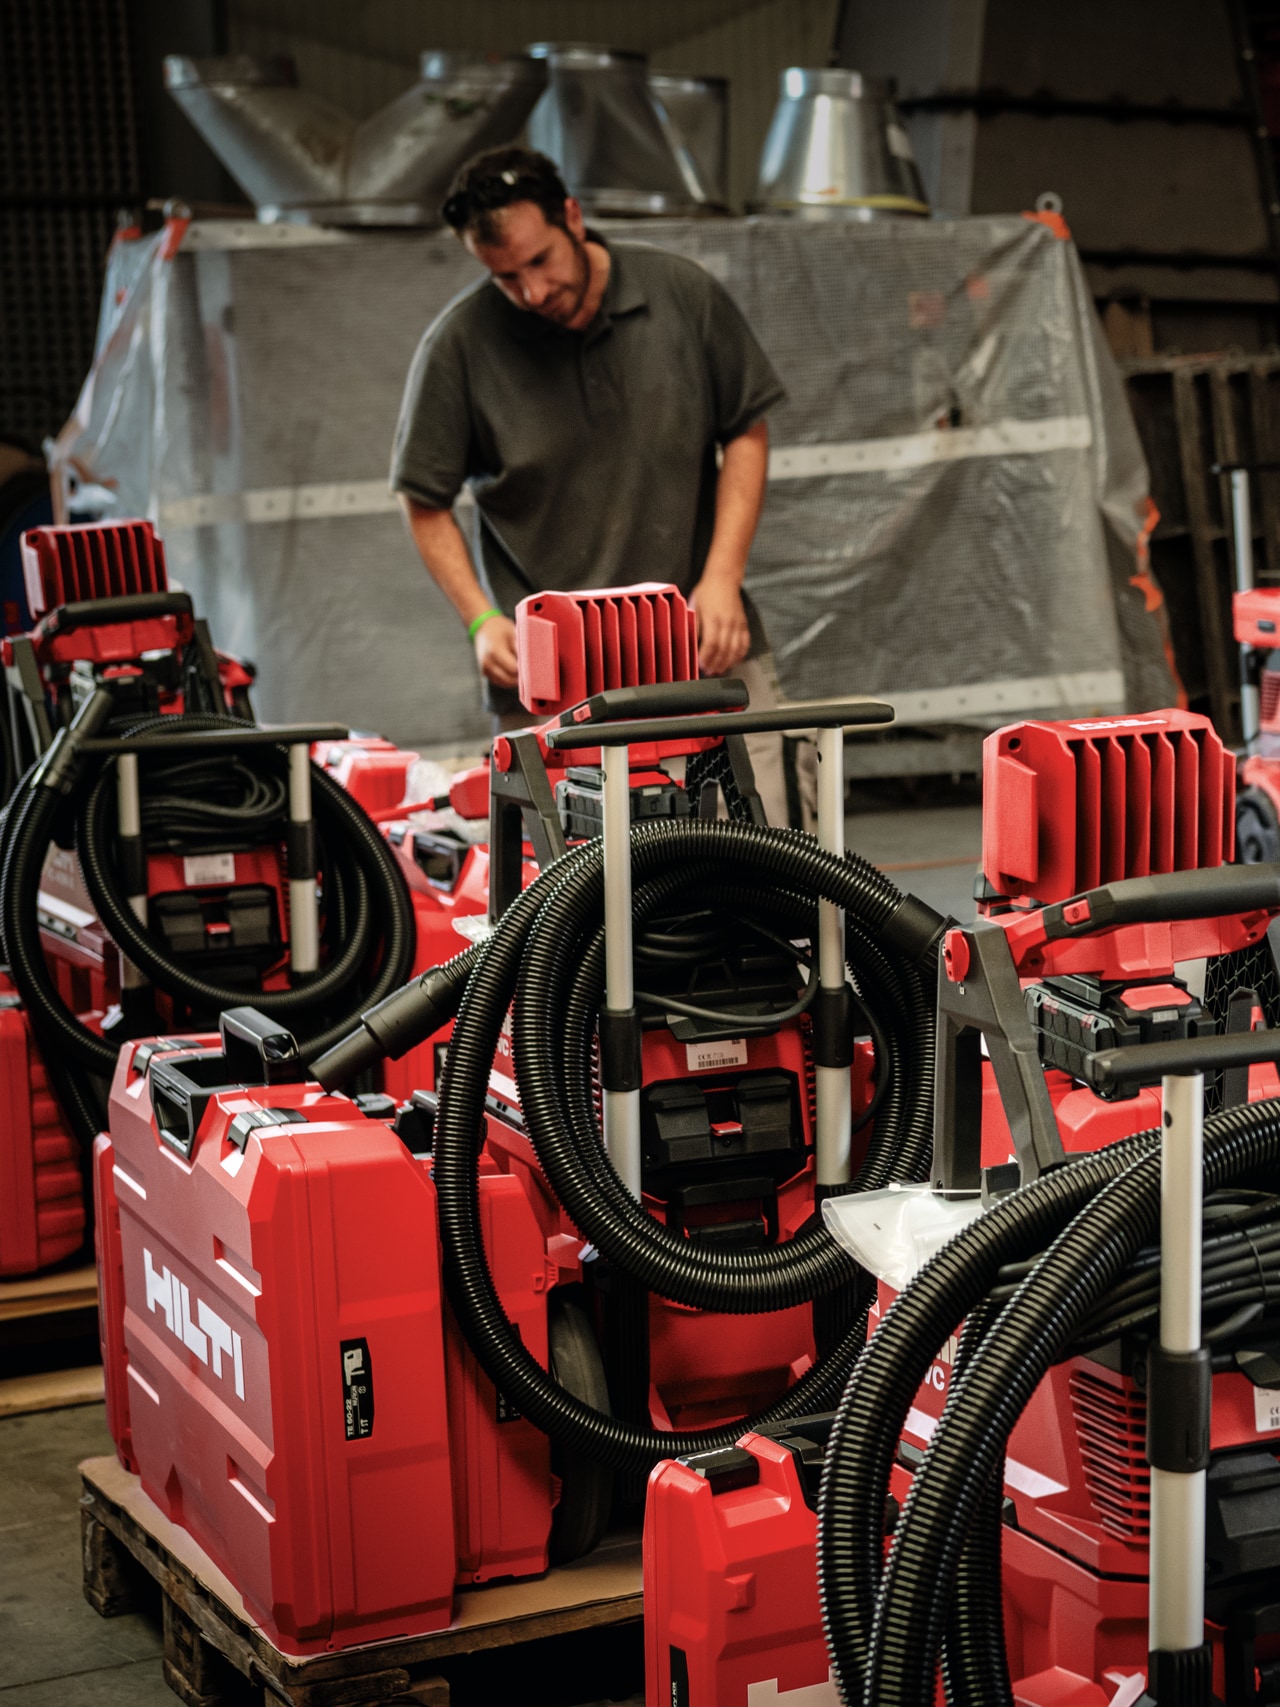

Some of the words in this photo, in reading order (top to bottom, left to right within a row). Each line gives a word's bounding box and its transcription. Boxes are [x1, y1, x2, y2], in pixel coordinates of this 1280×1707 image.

[143, 1247, 245, 1402] HILTI
[345, 1398, 353, 1425] 60-22
[346, 1425, 354, 1437] TE
